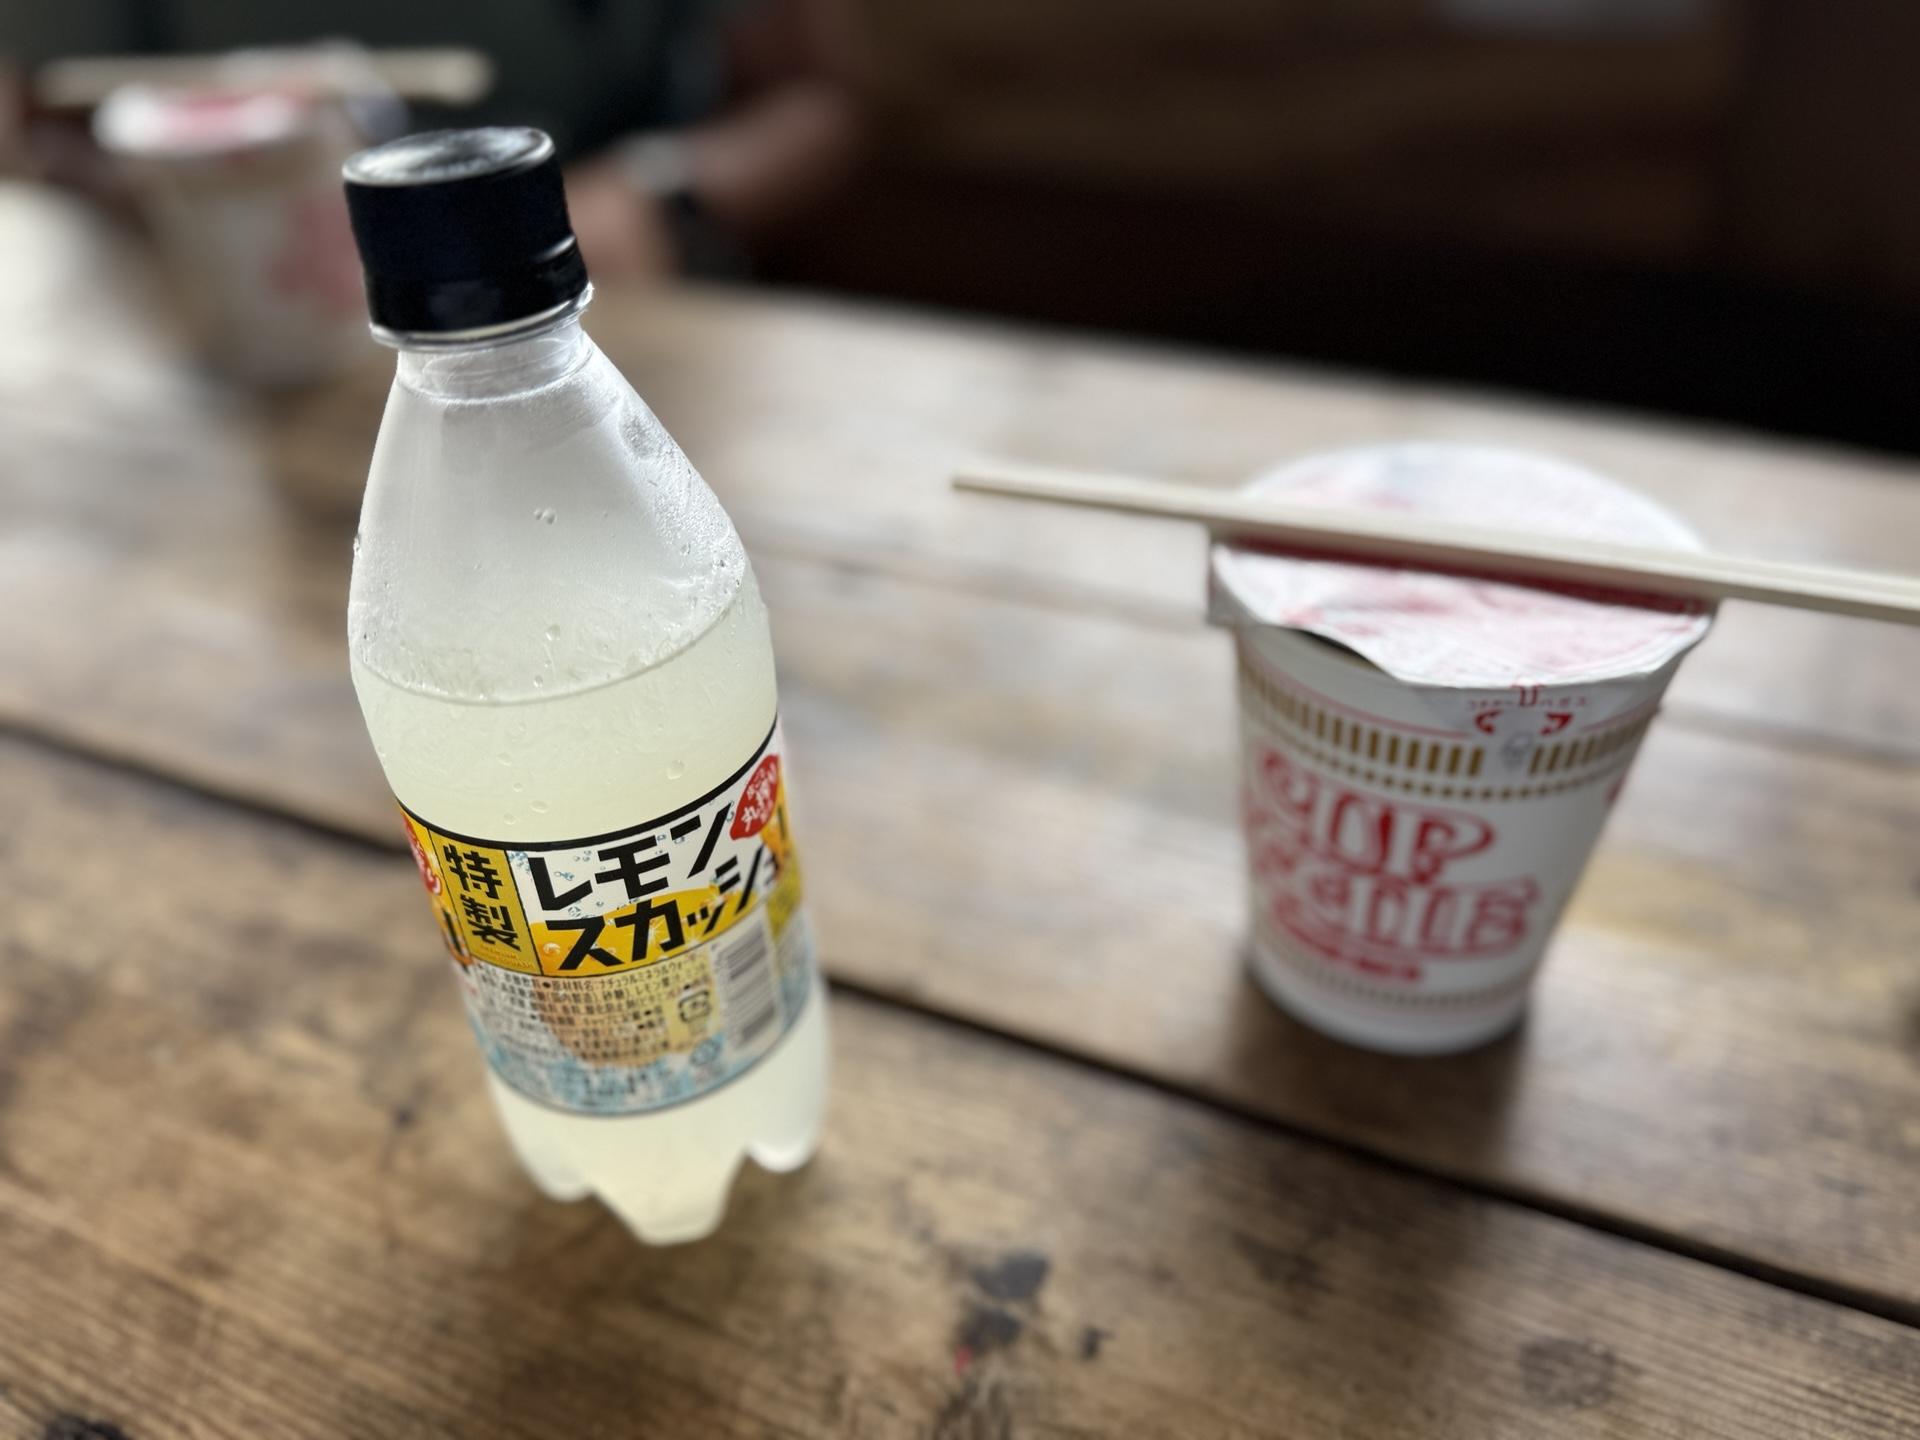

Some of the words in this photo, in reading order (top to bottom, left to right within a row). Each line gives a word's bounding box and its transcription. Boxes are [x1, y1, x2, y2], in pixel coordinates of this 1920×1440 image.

[443, 844, 522, 952] 特製
[528, 802, 732, 911] レモン
